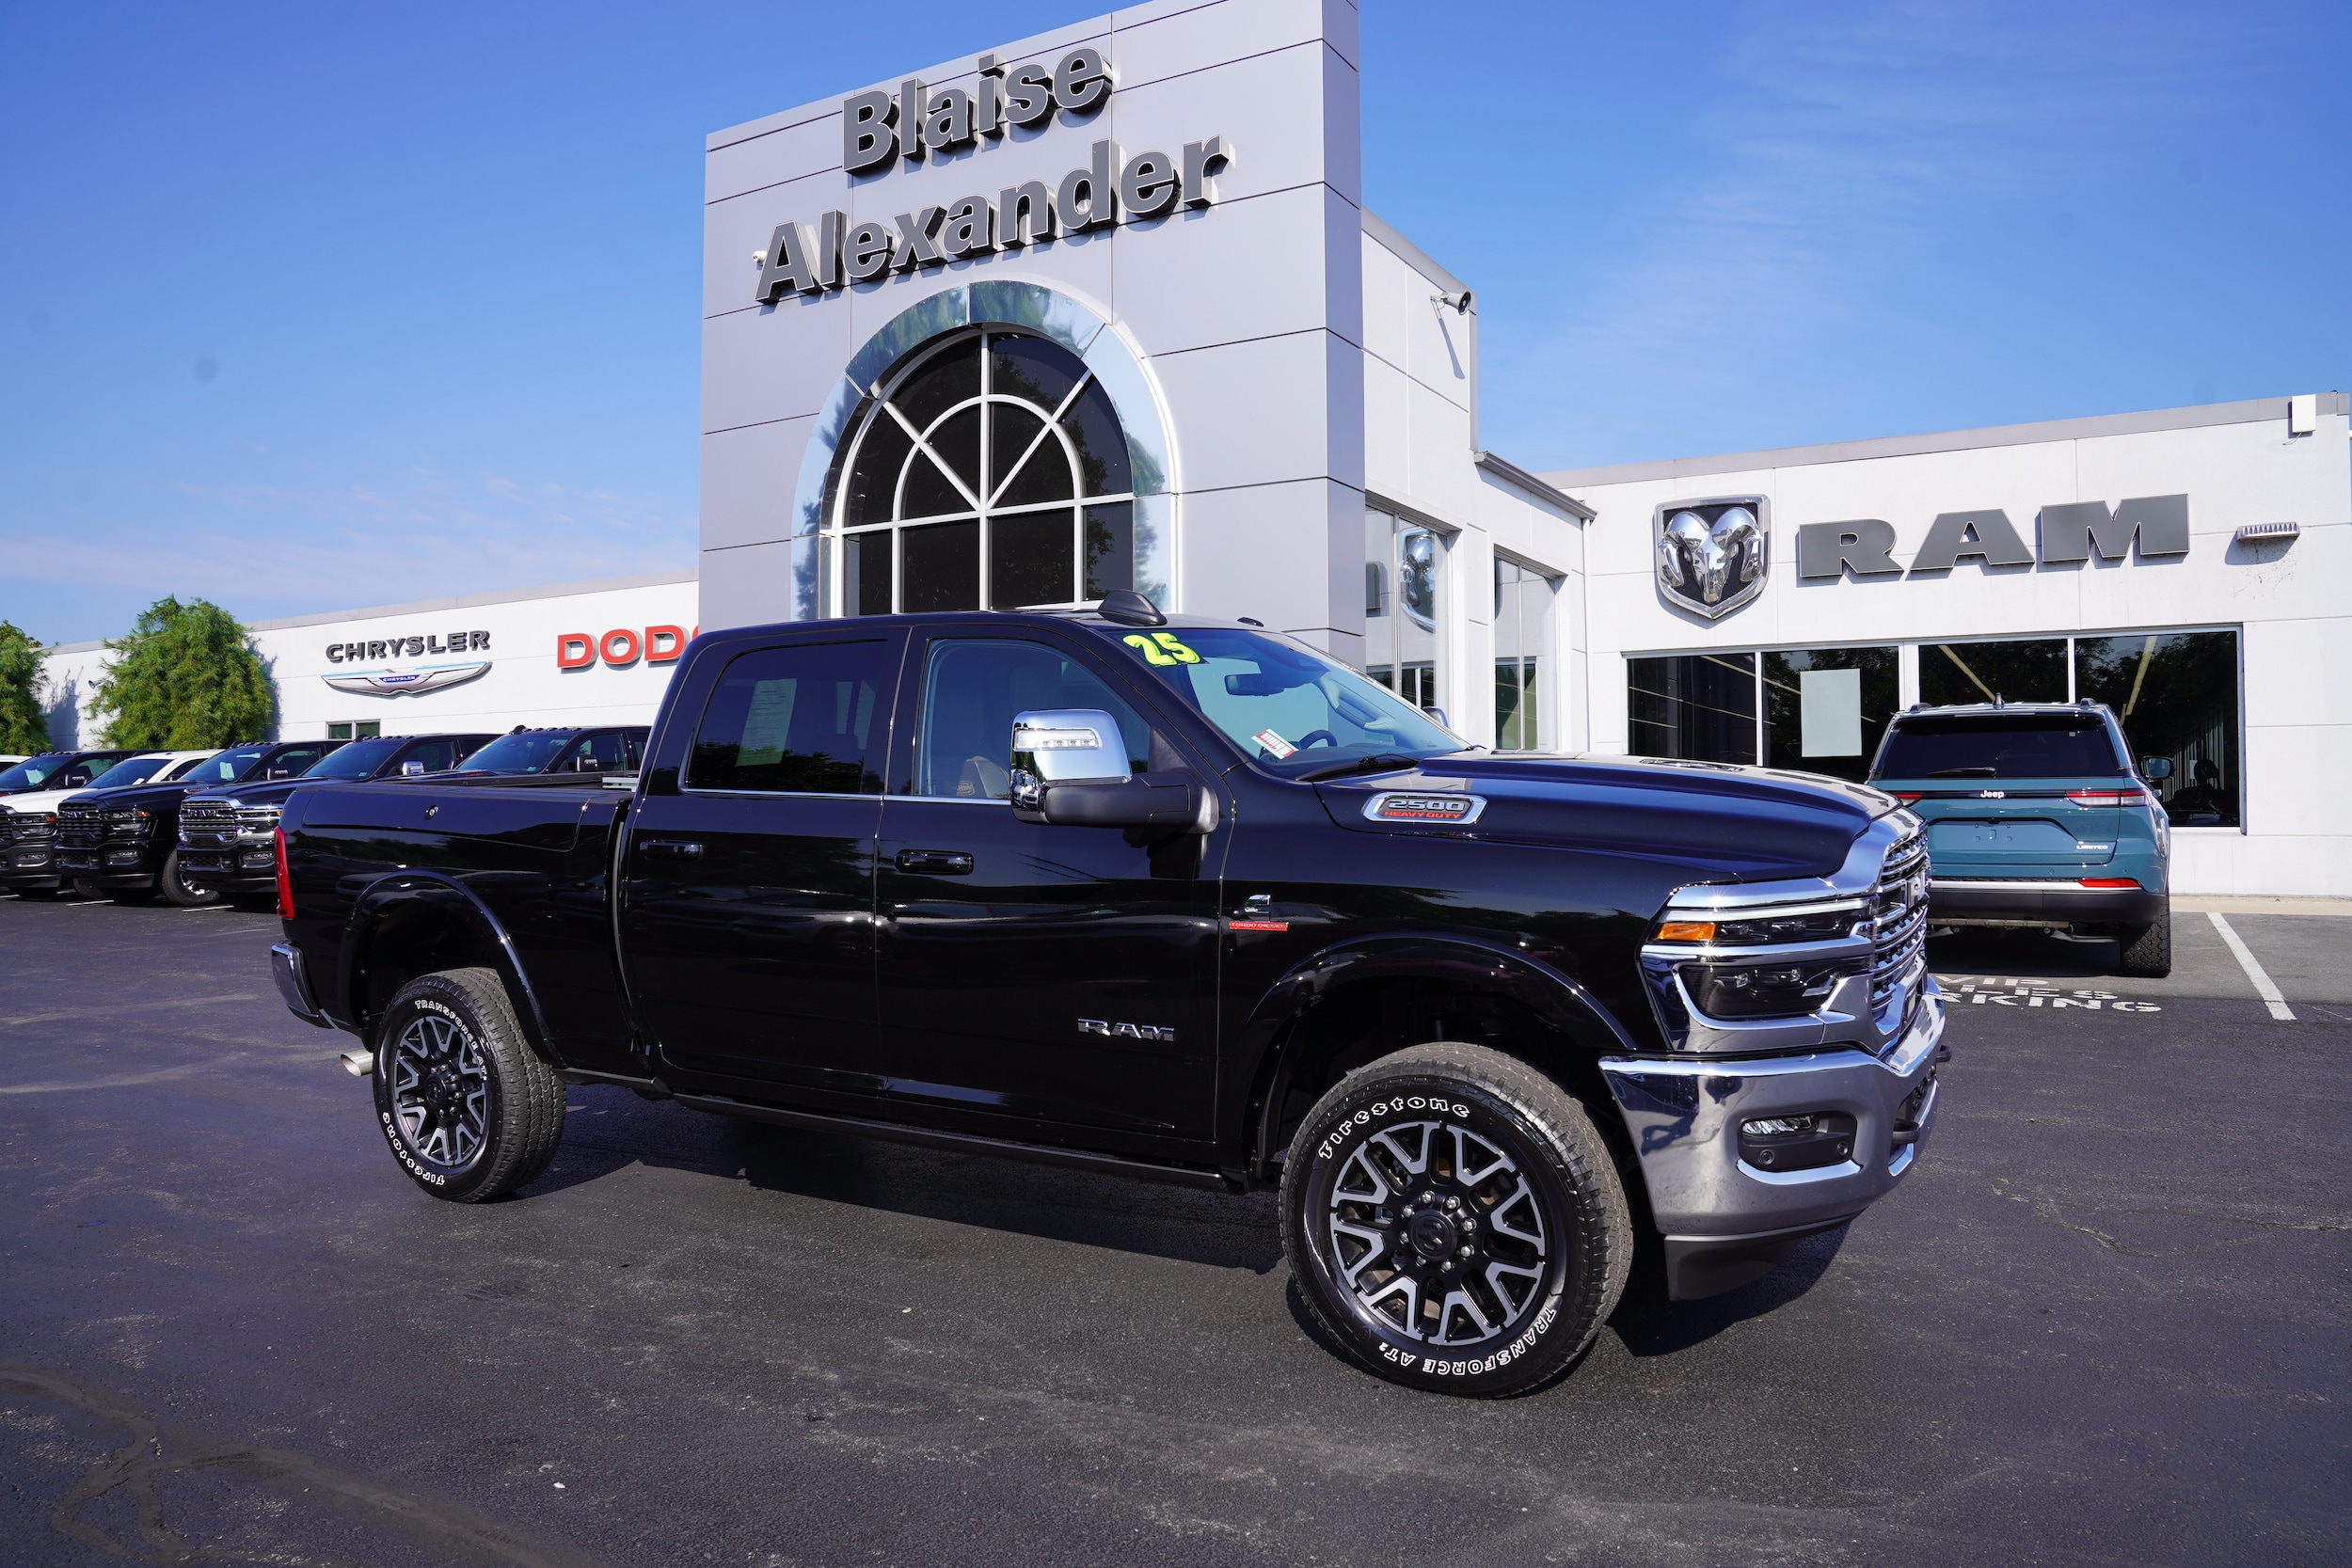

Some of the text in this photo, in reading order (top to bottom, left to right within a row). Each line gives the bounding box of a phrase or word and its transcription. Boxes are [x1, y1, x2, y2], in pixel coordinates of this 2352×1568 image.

[842, 46, 1111, 174] Blaise
[754, 135, 1230, 303] Alexander
[1798, 493, 2189, 578] RAM
[326, 630, 490, 662] CHRYSLER
[557, 625, 698, 668] DOD
[1122, 632, 1201, 667] 25
[1389, 800, 1465, 812] 2500
[1980, 790, 2005, 799] Jeep
[414, 999, 479, 1051] TRANSFORCE
[1077, 1019, 1175, 1042] RAM
[382, 1112, 446, 1186] Firestone
[1318, 1096, 1470, 1160] Firestone
[1422, 1306, 1557, 1376] TRANSFORCE
